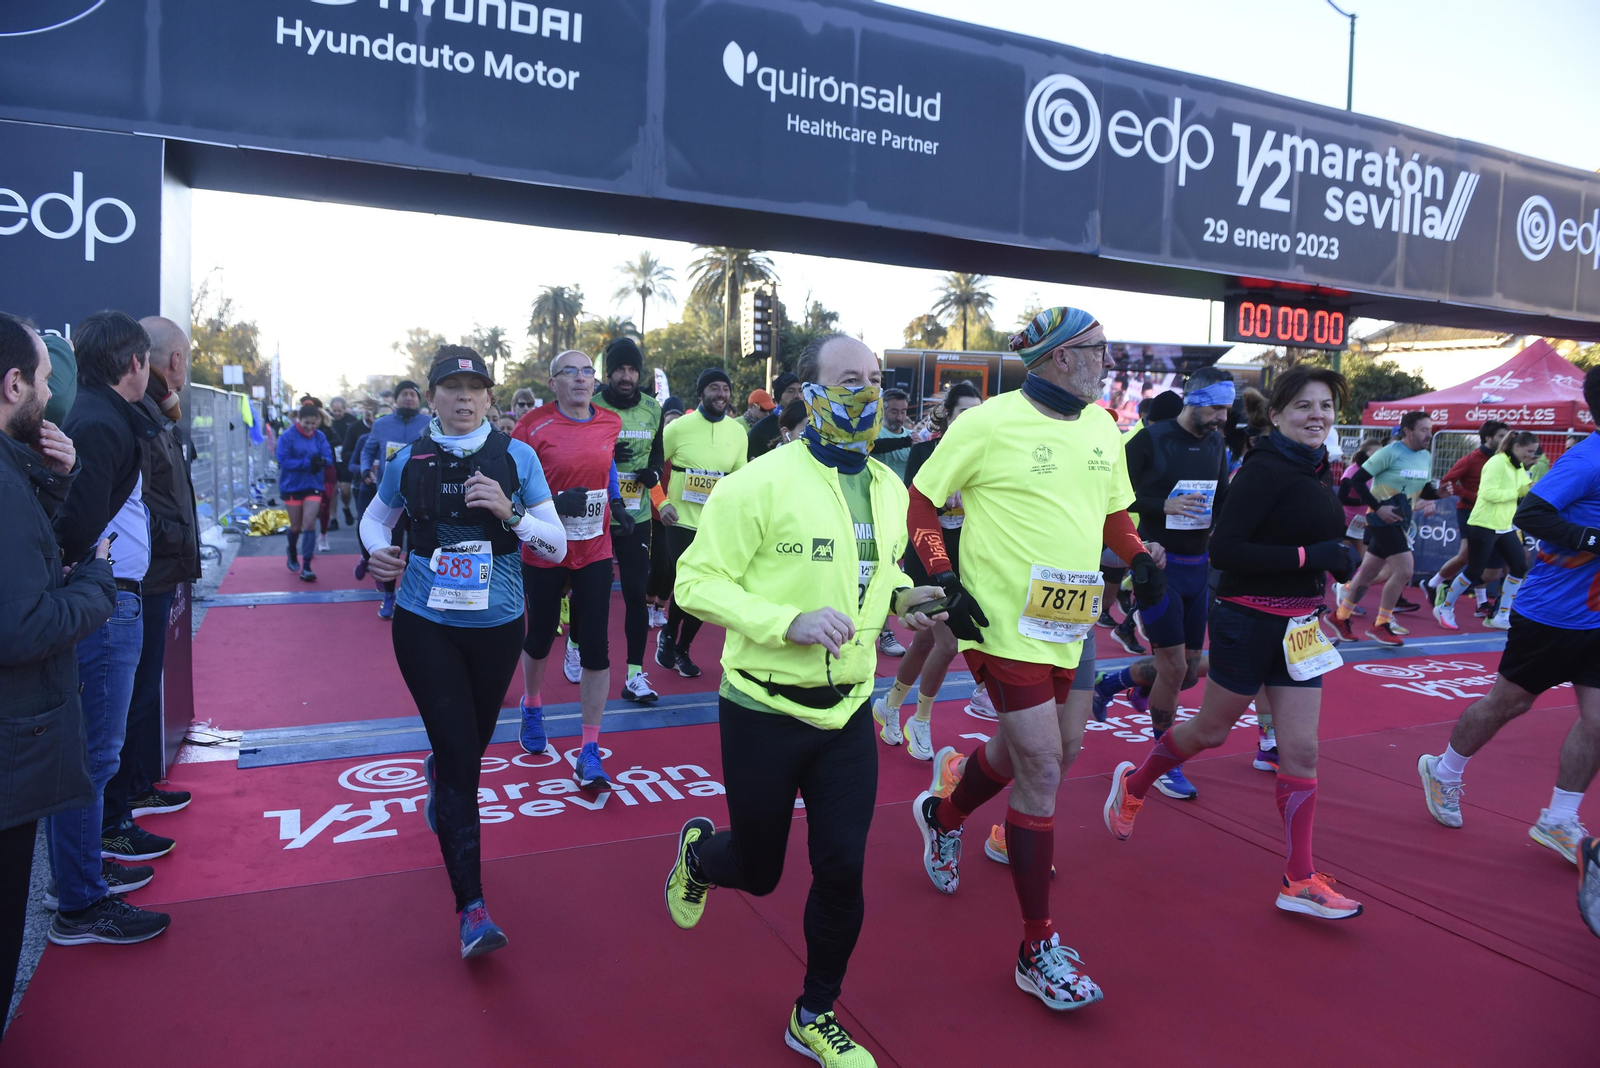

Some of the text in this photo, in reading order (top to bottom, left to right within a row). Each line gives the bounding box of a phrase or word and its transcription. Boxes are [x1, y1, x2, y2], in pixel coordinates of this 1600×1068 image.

[276, 16, 580, 91] Hyundauto Motor
[757, 66, 942, 122] quirónsalud
[787, 113, 939, 156] Healthcare Partner
[1108, 97, 1215, 187] edp
[1281, 132, 1445, 201] maratón
[0, 171, 136, 262] edp
[1323, 185, 1443, 241] sevilla
[1203, 217, 1340, 261] 29 enero 2023
[1558, 208, 1600, 270] ed
[619, 481, 638, 493] 768
[688, 476, 718, 489] 10267
[1419, 520, 1457, 547] edp
[436, 555, 473, 579] 583
[1040, 585, 1087, 612] 7871
